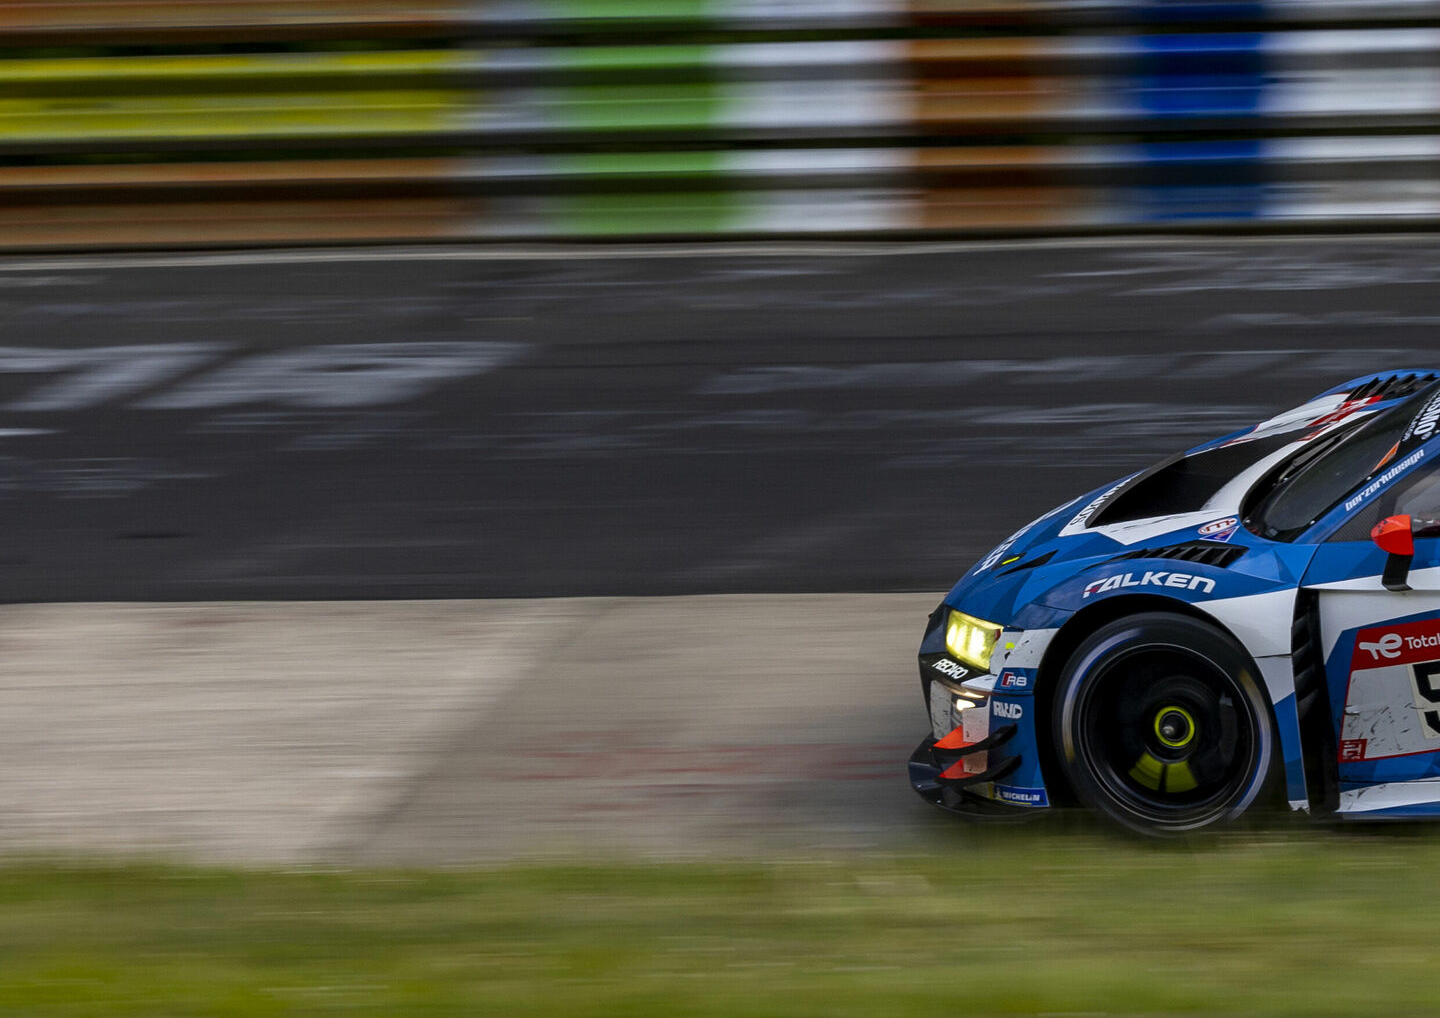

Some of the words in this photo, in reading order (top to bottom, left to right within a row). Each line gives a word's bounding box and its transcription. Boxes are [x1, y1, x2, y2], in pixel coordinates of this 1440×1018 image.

[1082, 571, 1216, 599] FALKEN
[932, 658, 969, 679] RECARO
[1003, 673, 1027, 687] R8
